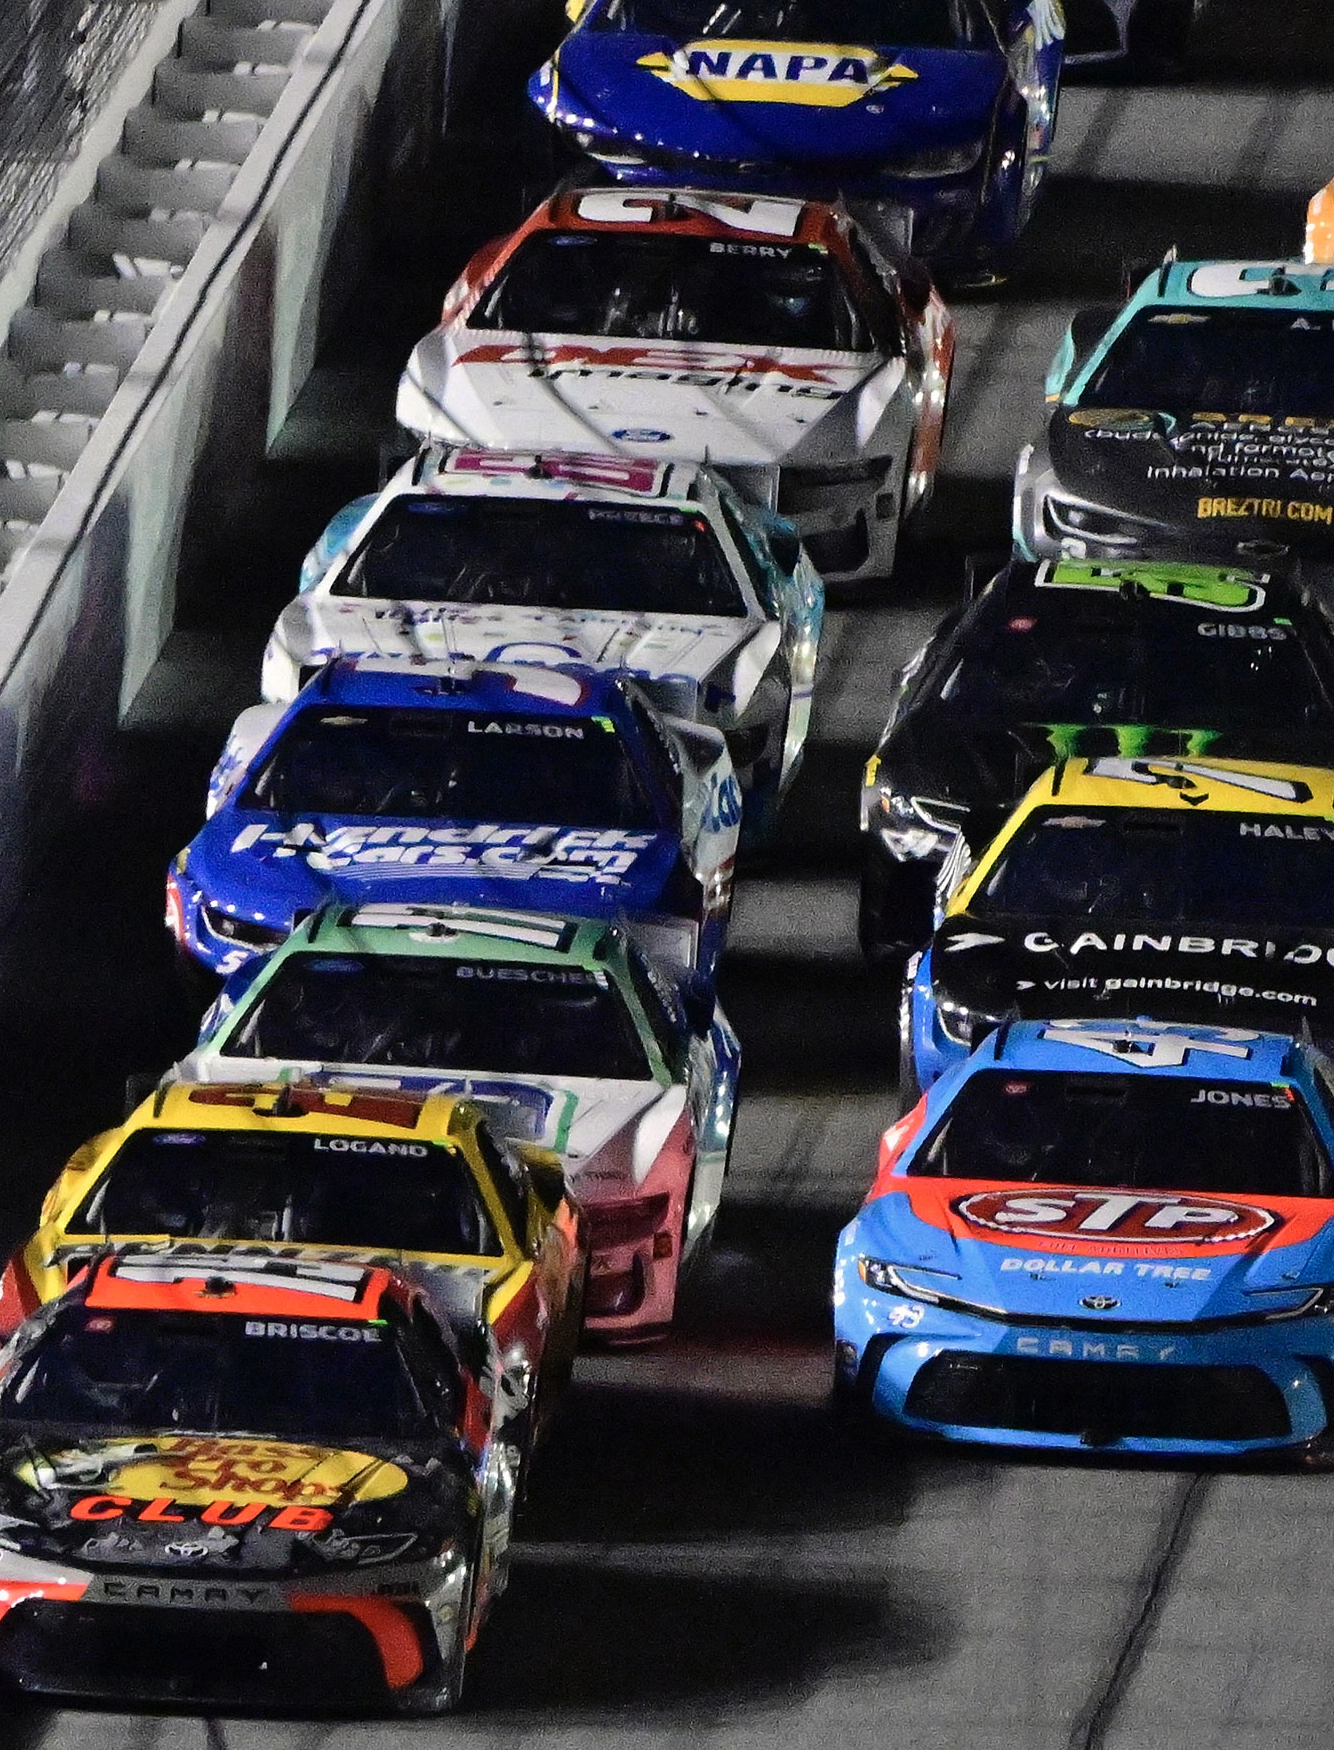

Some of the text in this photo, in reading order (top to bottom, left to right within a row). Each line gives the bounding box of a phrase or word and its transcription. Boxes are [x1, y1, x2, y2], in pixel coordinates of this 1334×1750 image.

[686, 51, 871, 83] NAPA
[709, 242, 792, 259] BERRY
[1289, 316, 1321, 332] A.
[1146, 464, 1280, 480] Inhalation
[1197, 497, 1333, 526] BREZTRI.COM
[467, 720, 585, 740] LARSON
[1044, 976, 1318, 1007] visit gainbridge.com
[1189, 1088, 1292, 1110] JONES
[313, 1137, 429, 1160] LOGANO
[993, 1192, 1239, 1233] STP
[999, 1258, 1213, 1282] DOLLAR TREE
[887, 1302, 927, 1330] 43
[243, 1319, 383, 1344] BRISCOE
[1014, 1336, 1175, 1362] CAMRY
[69, 1495, 334, 1532] CLUB
[103, 1581, 270, 1604] CAMRY
